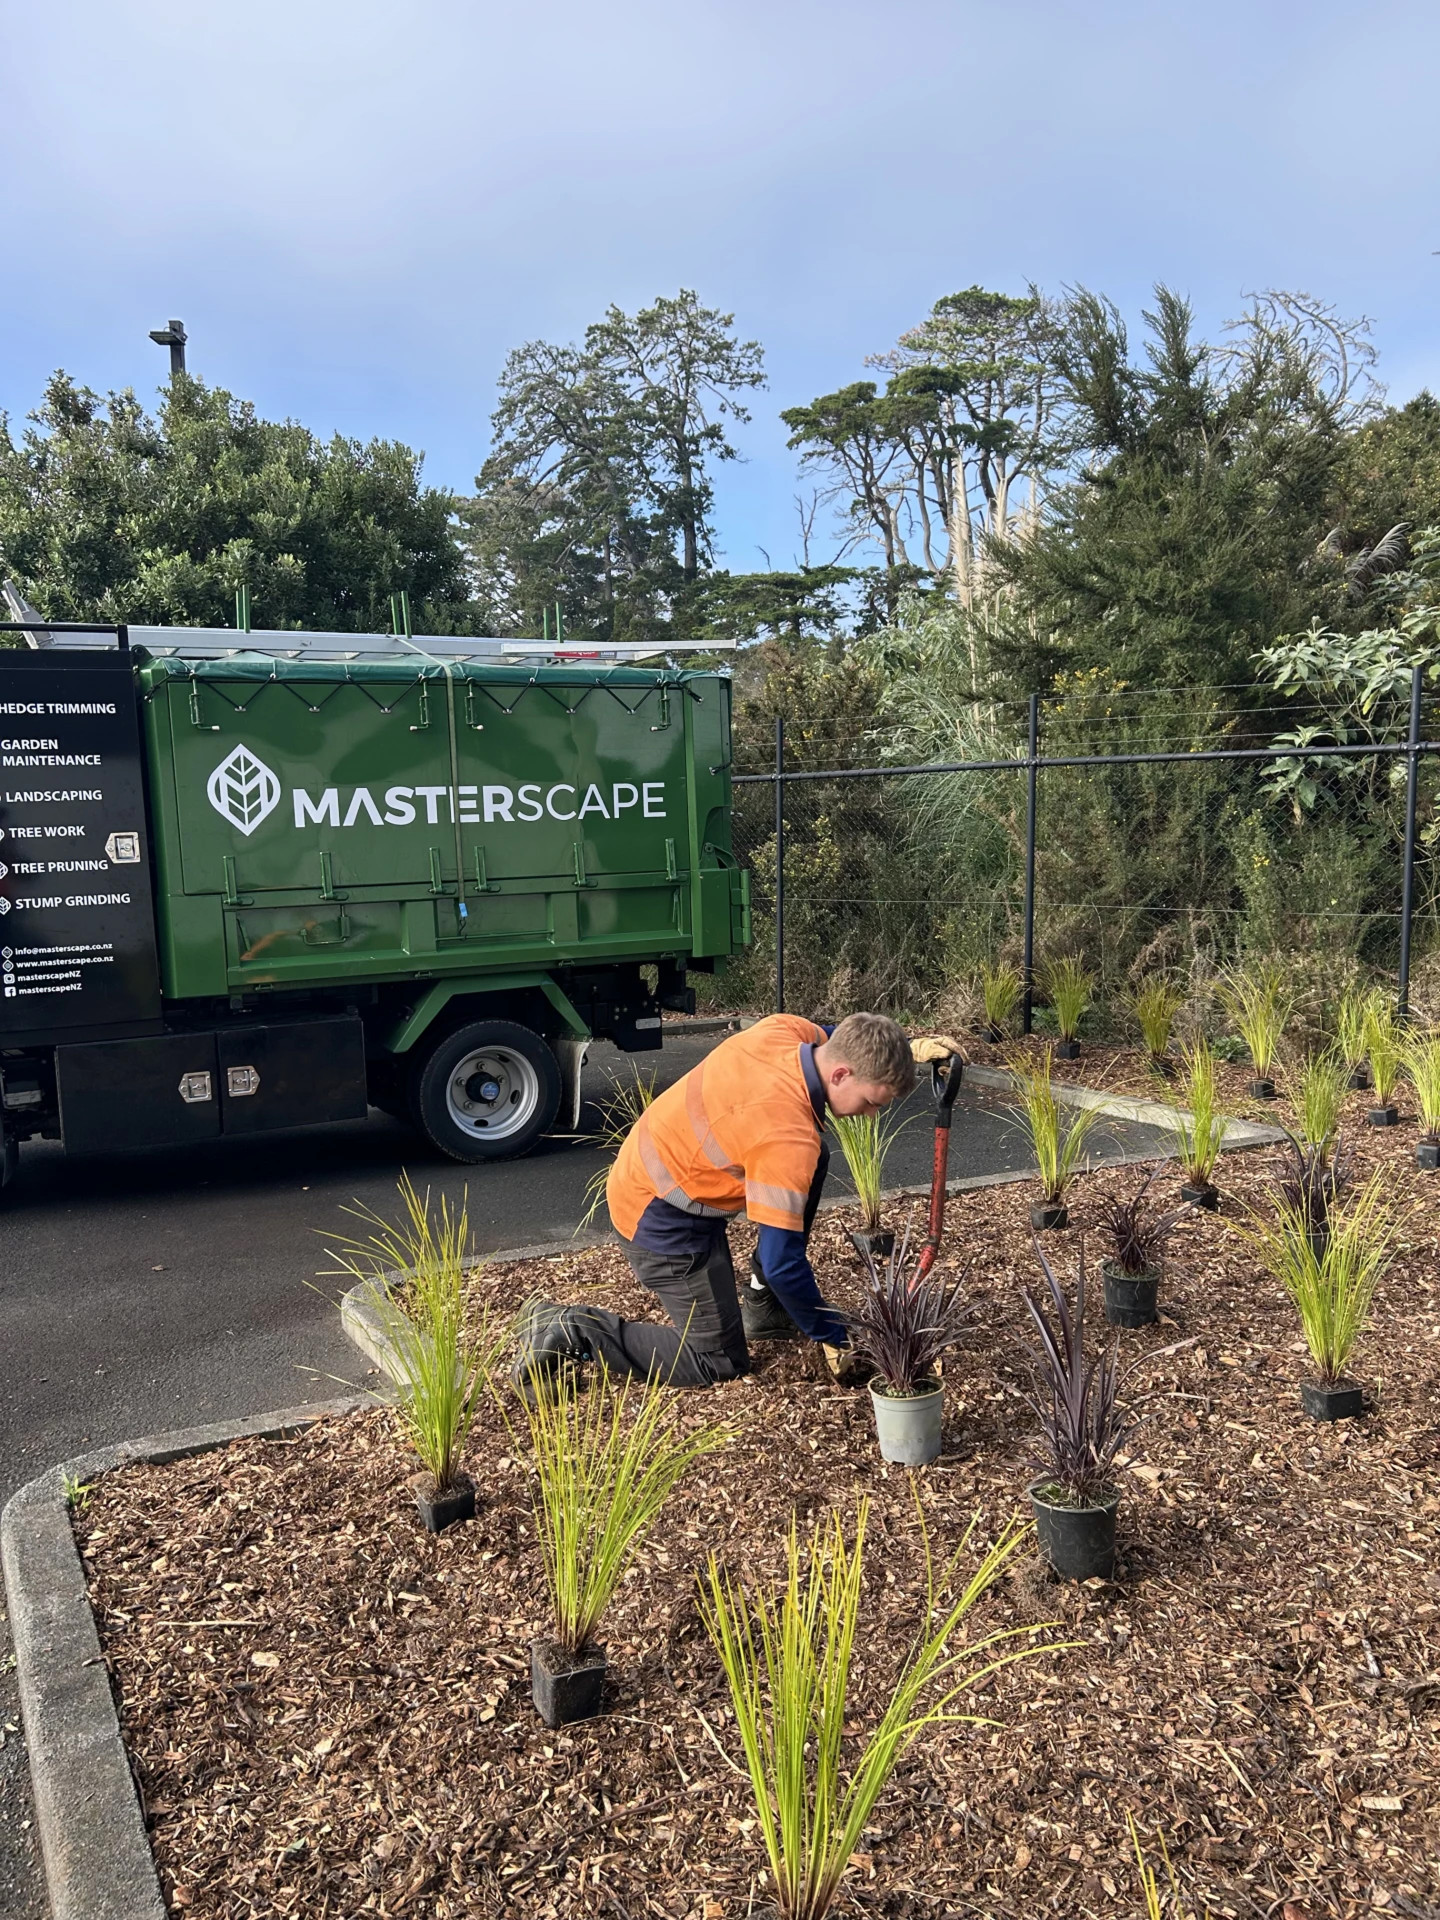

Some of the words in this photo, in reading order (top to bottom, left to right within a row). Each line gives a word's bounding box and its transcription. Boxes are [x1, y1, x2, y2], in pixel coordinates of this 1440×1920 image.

[0, 703, 44, 714] HEDGE
[46, 703, 116, 714] TRIMMING
[1, 739, 58, 750] GARDEN
[3, 754, 101, 766] MAINTENANCE
[6, 790, 102, 802] LANDSCAPING
[293, 782, 667, 828] MASTERSCAPE
[9, 826, 42, 838] TREE
[44, 825, 86, 837] WORK
[12, 862, 45, 874] TREE
[48, 859, 108, 872] PRUNING
[16, 897, 62, 909] STUMP
[65, 893, 131, 906] GRINDING
[15, 943, 113, 956] info@masterscape.co.nz
[16, 956, 114, 969] www.masterscape.co.nz
[18, 970, 81, 982] masterscapeNZ
[19, 983, 82, 995] masterscapeNZ
